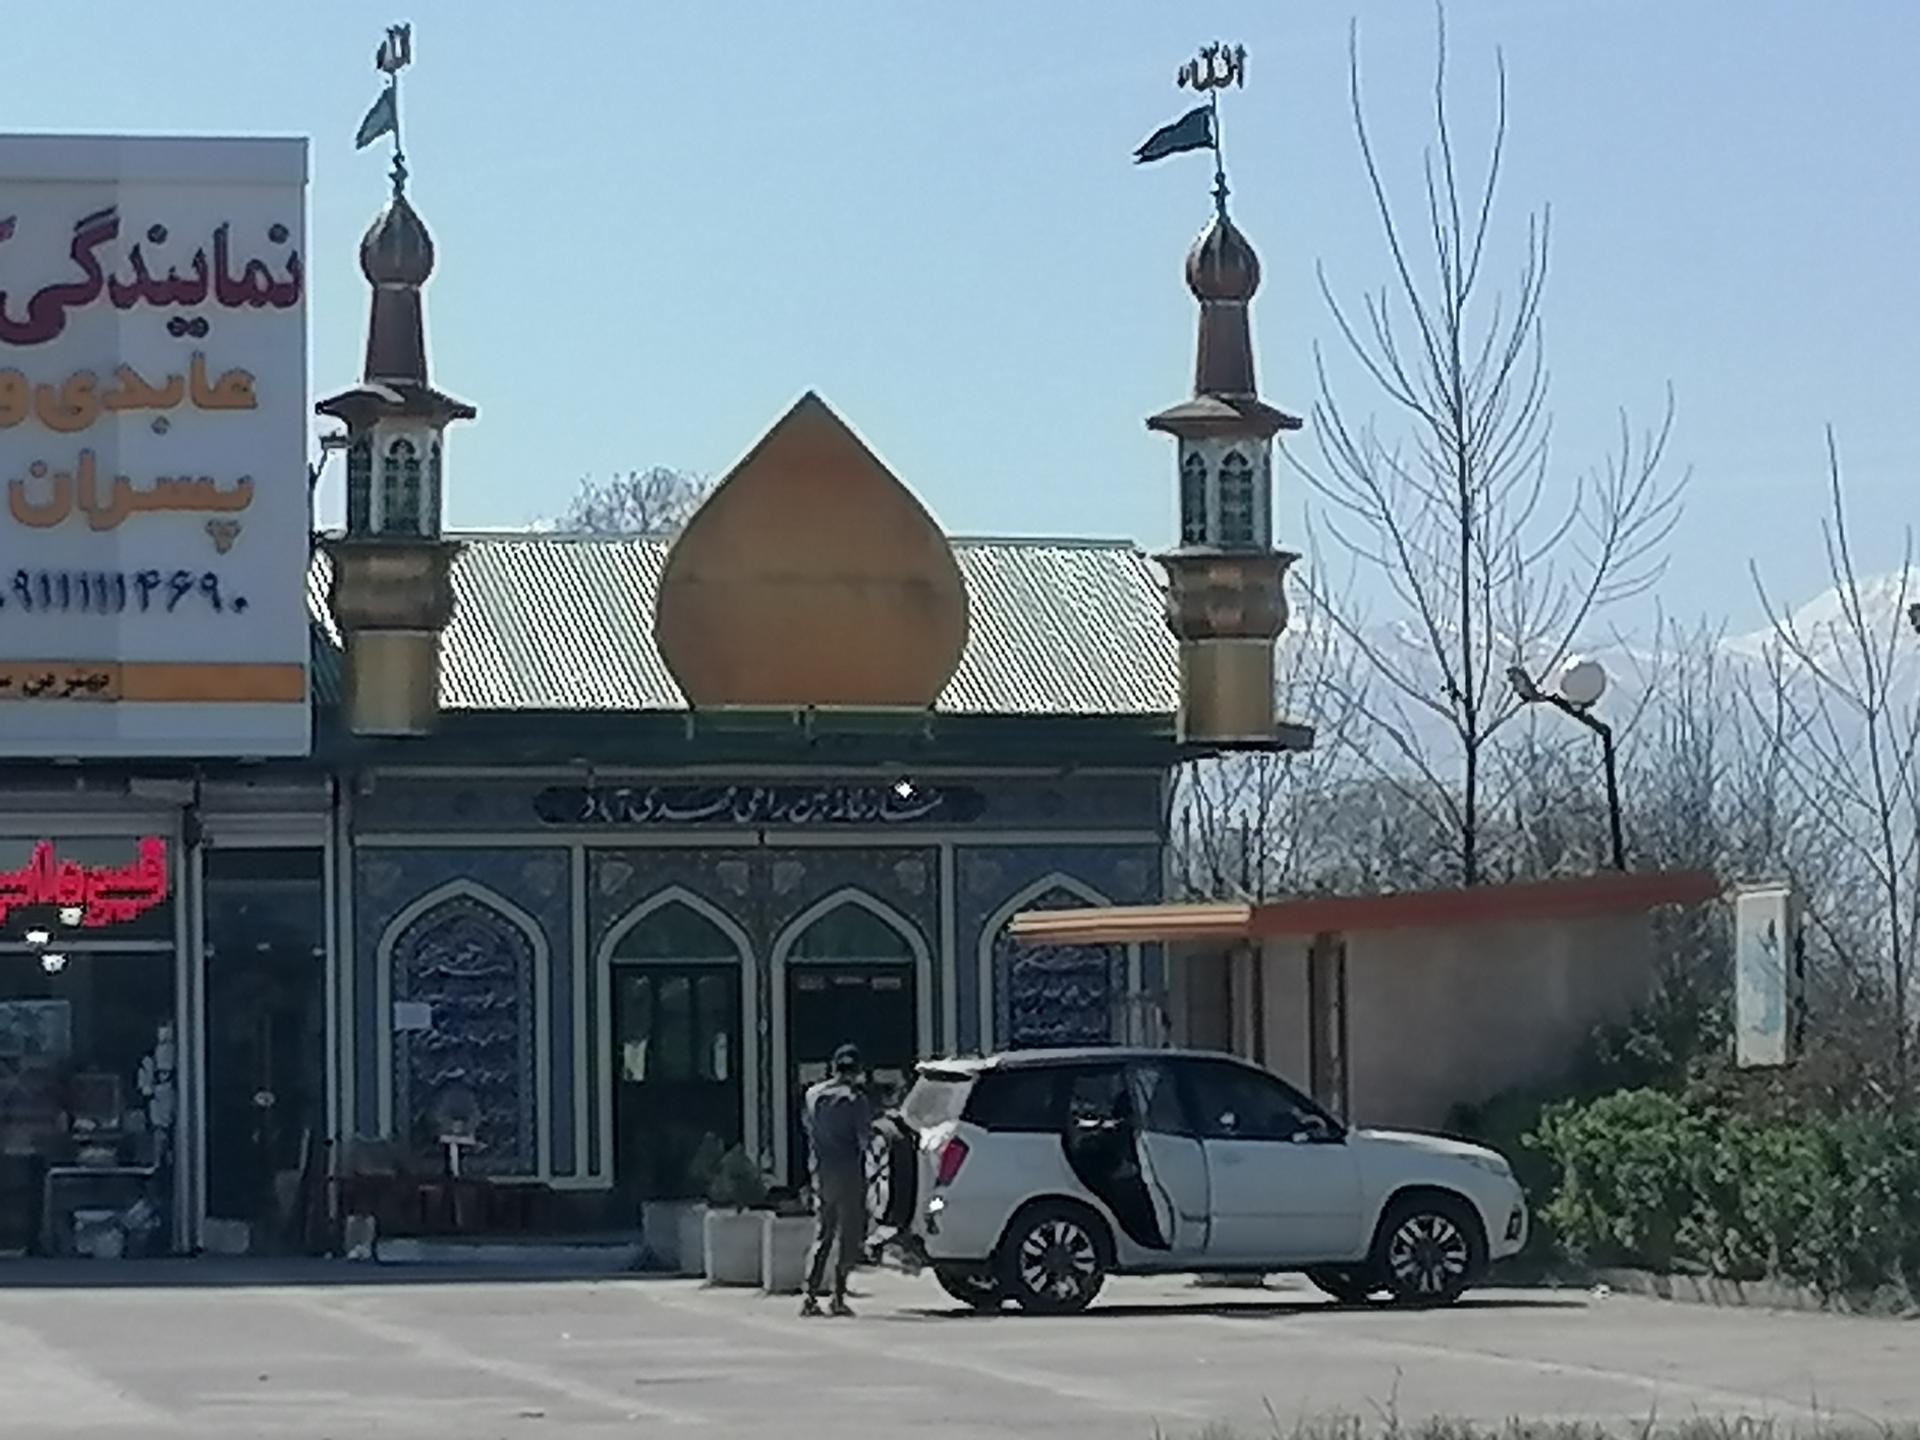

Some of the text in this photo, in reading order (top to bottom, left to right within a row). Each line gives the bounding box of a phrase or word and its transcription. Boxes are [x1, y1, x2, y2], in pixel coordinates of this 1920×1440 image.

[0, 204, 303, 345] نمایندگی
[34, 351, 258, 436] عابدی
[9, 448, 253, 555] پسران
